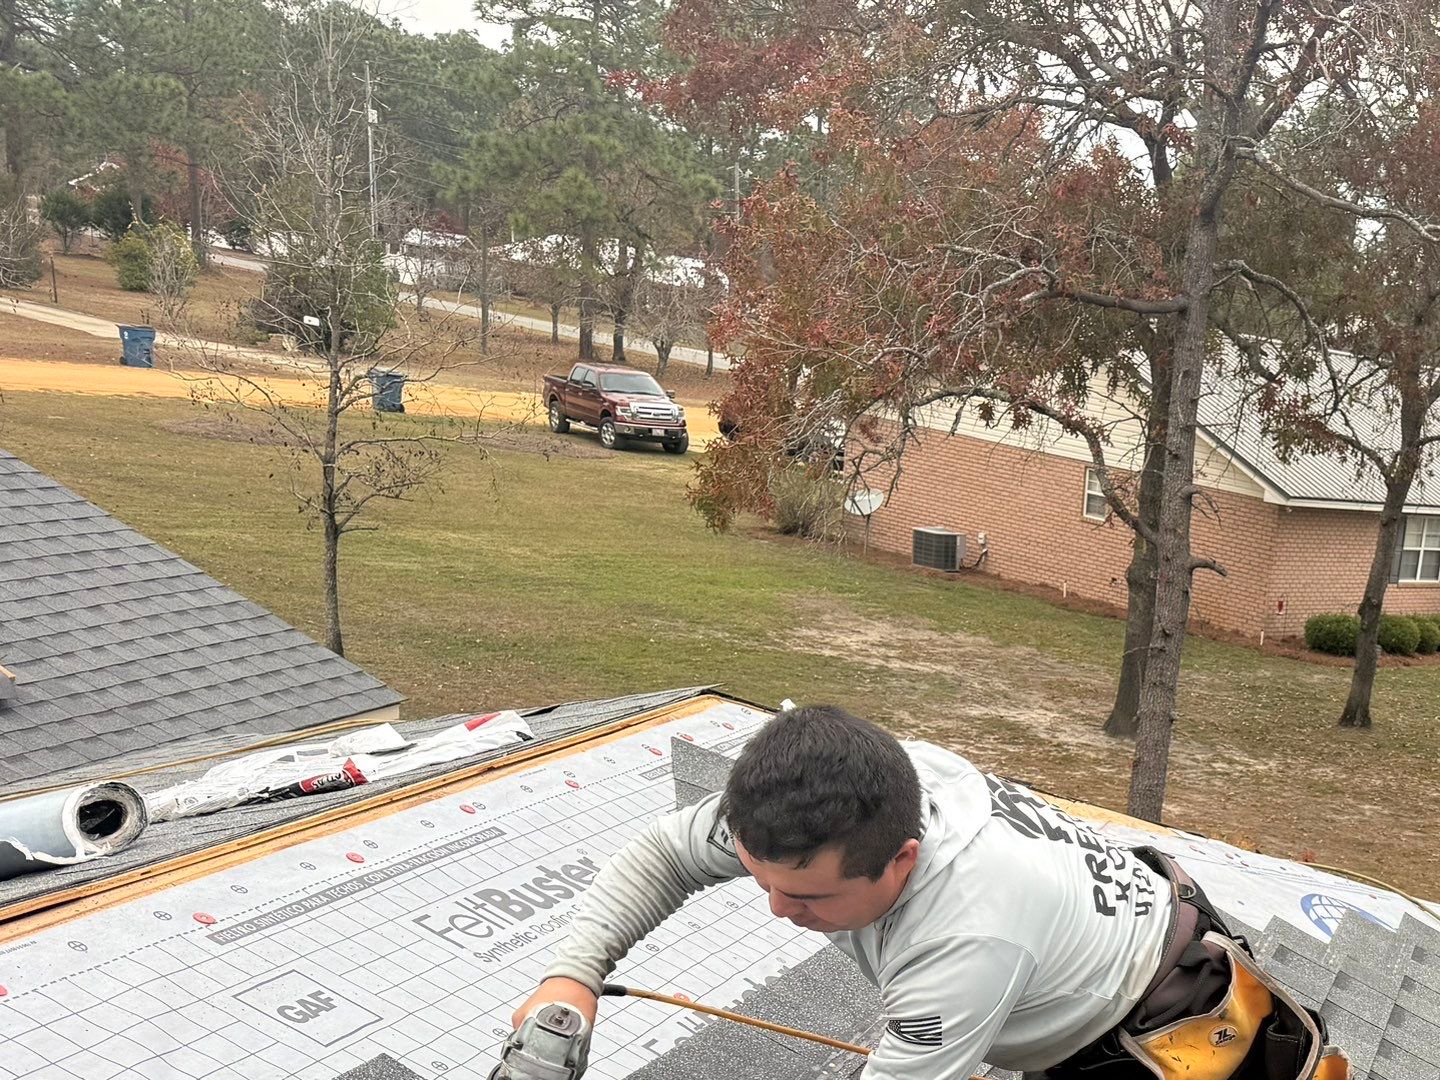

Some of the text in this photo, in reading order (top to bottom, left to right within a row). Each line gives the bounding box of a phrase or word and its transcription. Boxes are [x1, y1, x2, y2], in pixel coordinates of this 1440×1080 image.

[216, 923, 255, 945] FIELTRO
[255, 903, 303, 931] SINTÉTICO
[302, 895, 328, 915] PARA
[327, 880, 365, 902] TECHOS,
[363, 871, 386, 888] CON
[446, 828, 502, 856] INCORPORADA
[473, 929, 539, 964] Synthetic
[275, 987, 337, 1028] GAF
